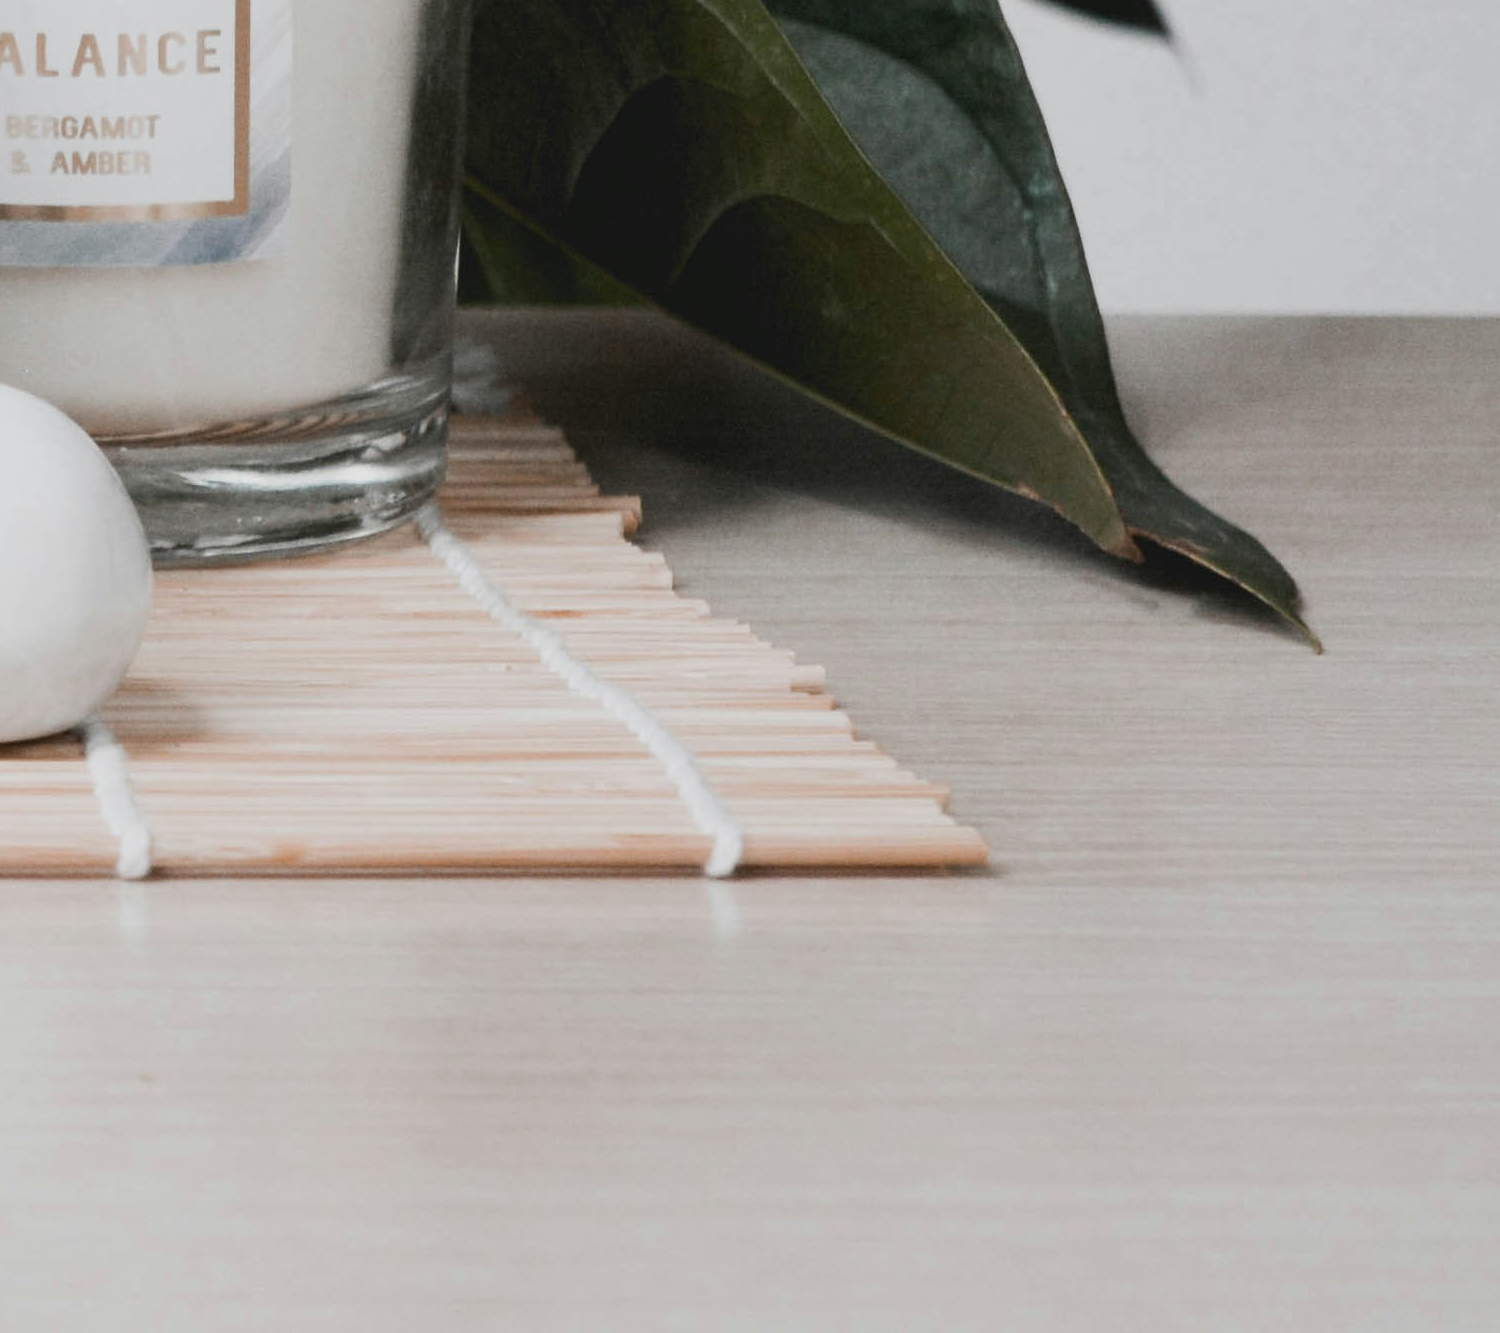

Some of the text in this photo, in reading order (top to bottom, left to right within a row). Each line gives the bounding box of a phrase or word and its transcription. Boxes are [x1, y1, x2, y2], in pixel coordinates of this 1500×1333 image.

[5, 115, 160, 139] BERGAMOT
[11, 151, 151, 174] & AMBER
